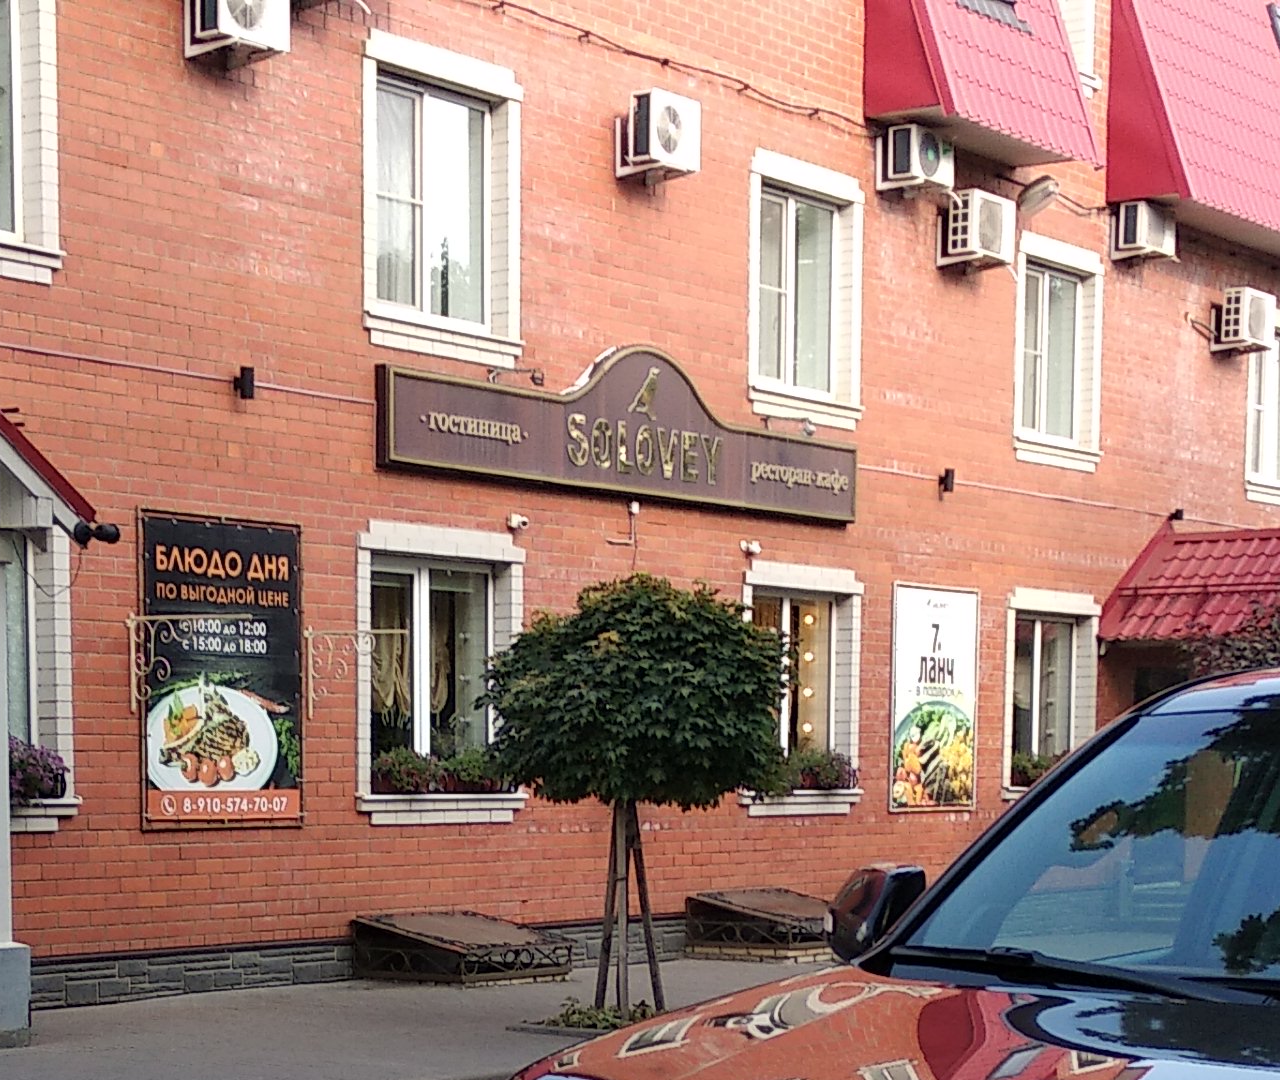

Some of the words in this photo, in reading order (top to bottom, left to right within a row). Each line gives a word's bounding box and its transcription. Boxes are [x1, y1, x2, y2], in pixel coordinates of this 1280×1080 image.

[566, 413, 723, 485] SOLOVEY
[155, 544, 242, 579] БЛЮДО
[247, 552, 289, 582] ДНЯ
[156, 582, 177, 600] ПО
[181, 584, 255, 606] ВЫГОДНОЙ
[258, 589, 289, 608] ЦЕНЕ
[193, 618, 221, 634] 10:00
[223, 624, 236, 635] до
[239, 620, 267, 637] 12:00
[193, 635, 221, 651] 15:00
[223, 642, 236, 653] до
[239, 638, 267, 654] 18:00
[918, 655, 955, 684] ланч
[183, 797, 287, 813] 8-910-574-70-07
